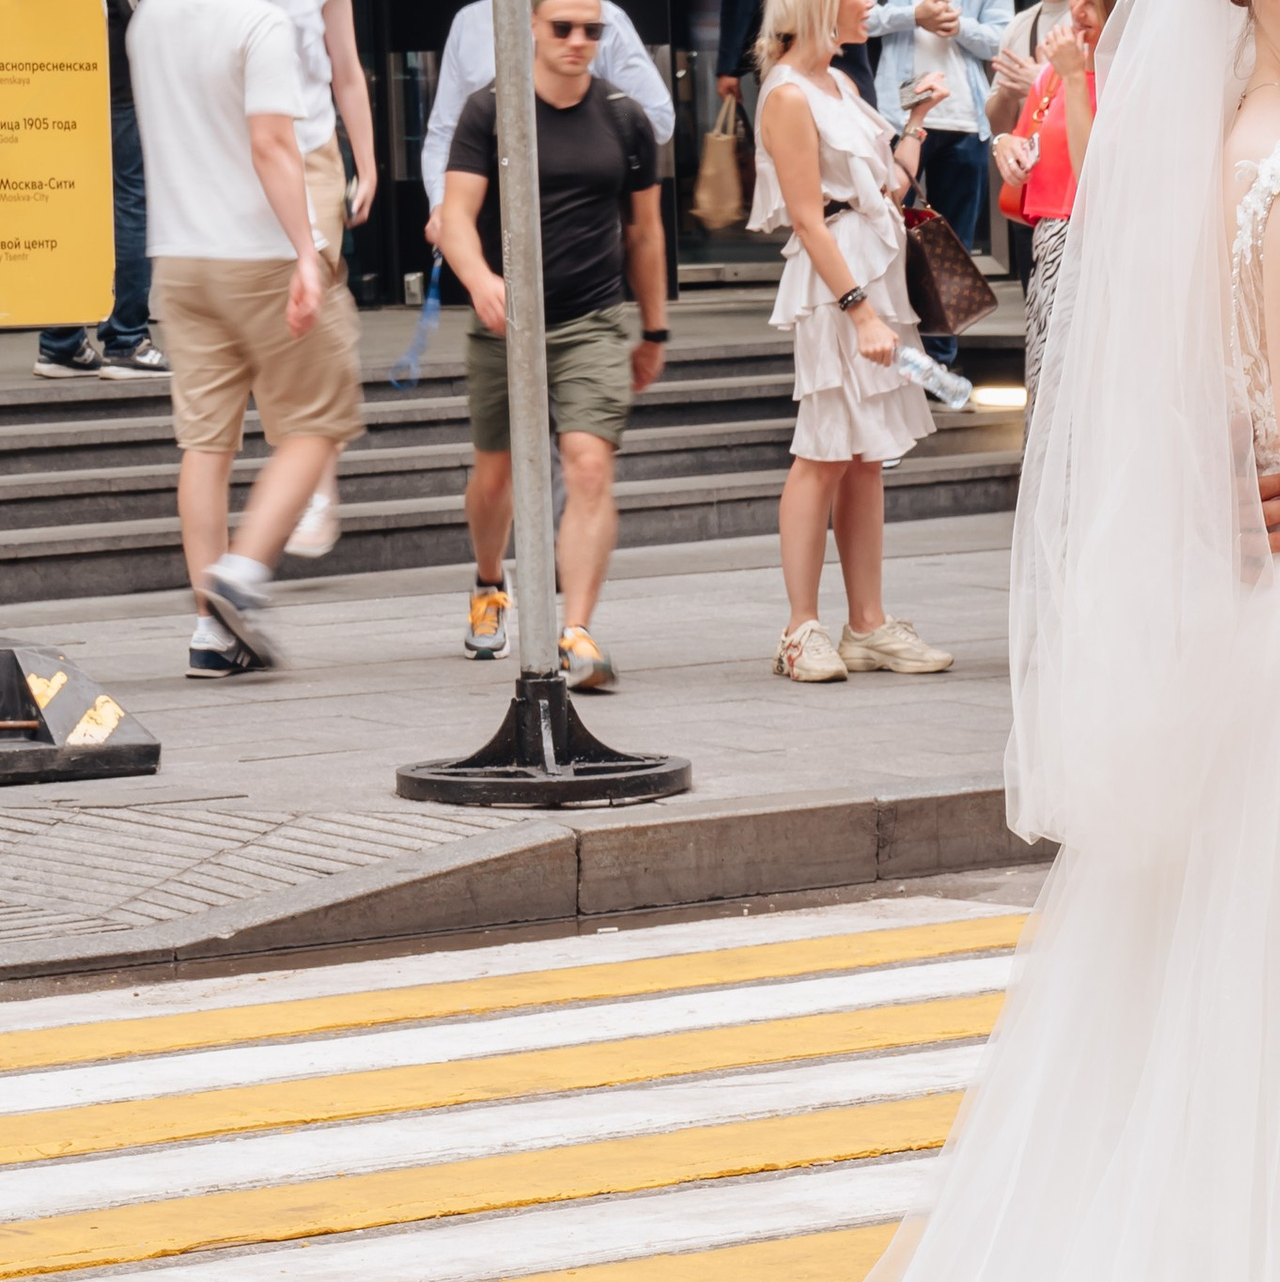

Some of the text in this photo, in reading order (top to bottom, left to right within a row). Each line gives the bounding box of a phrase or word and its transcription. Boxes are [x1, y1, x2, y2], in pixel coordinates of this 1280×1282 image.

[0, 62, 98, 74] аснопресненская
[23, 117, 50, 130] 1905
[52, 120, 77, 132] года
[0, 177, 75, 190] Москва-Сити
[0, 237, 58, 251] вой центр
